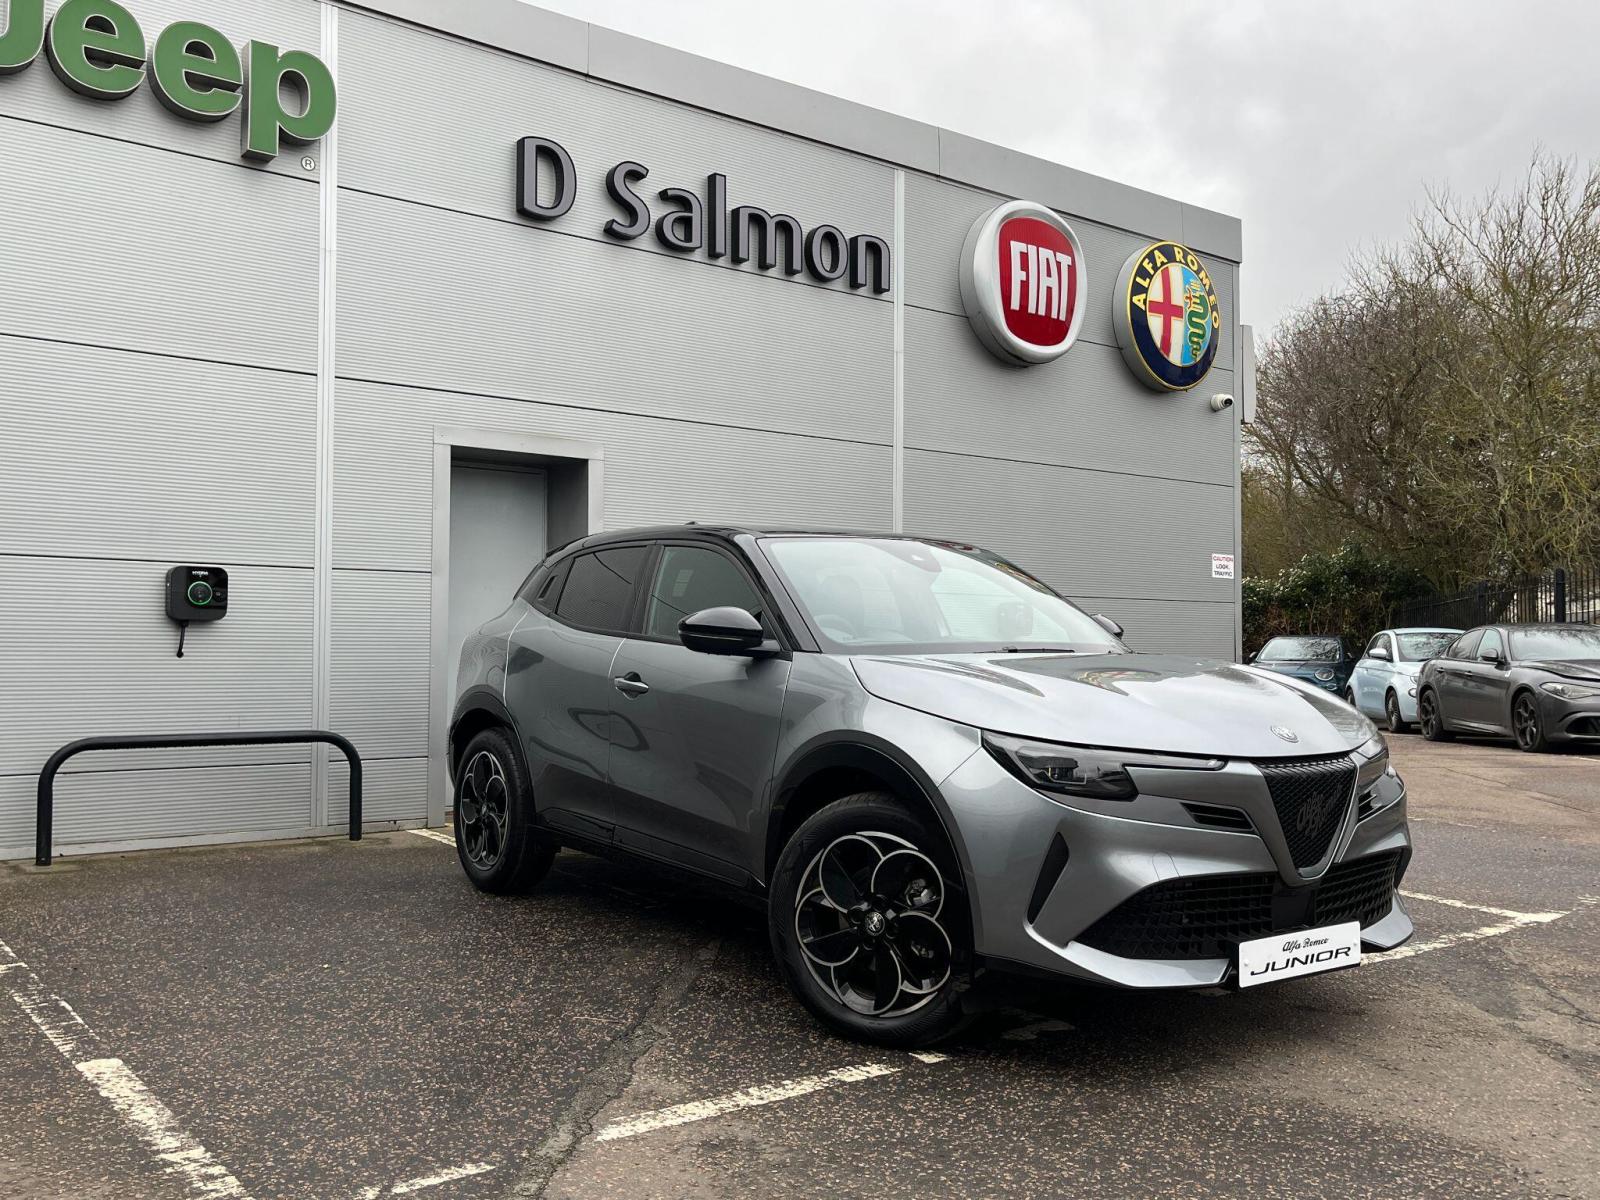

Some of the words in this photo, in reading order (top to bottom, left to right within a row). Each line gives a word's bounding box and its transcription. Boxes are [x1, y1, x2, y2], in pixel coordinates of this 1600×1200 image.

[516, 136, 577, 222] D
[603, 161, 891, 294] Salmon
[1009, 240, 1072, 322] FIAT
[1132, 247, 1168, 311] ALFA
[1175, 246, 1220, 330] ROMEO
[1250, 946, 1351, 976] JUNIOR
[1282, 940, 1301, 953] Alfa
[1303, 938, 1330, 949] Romeo
